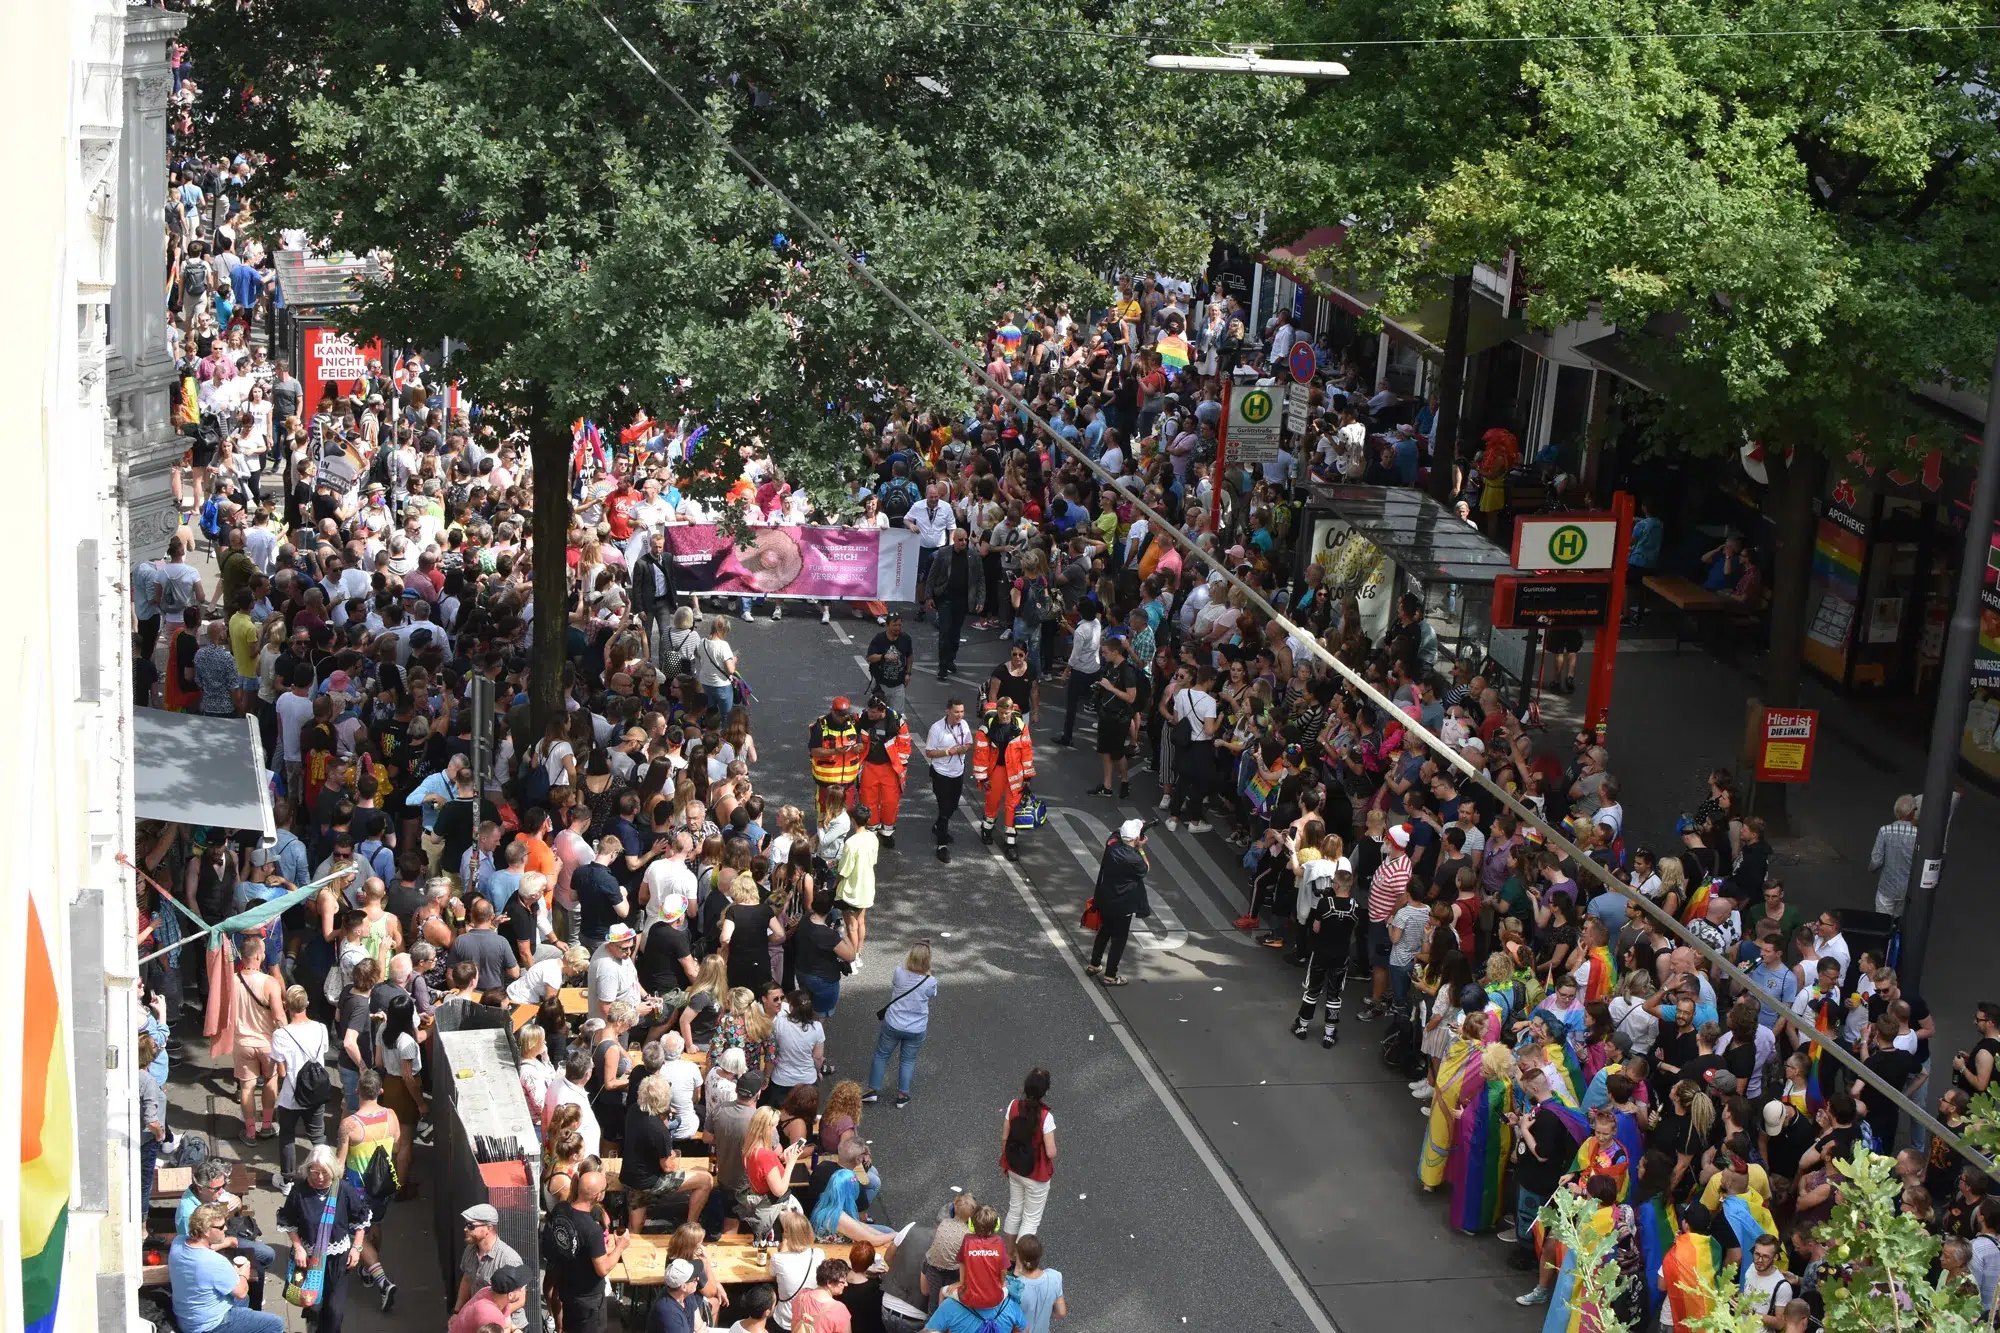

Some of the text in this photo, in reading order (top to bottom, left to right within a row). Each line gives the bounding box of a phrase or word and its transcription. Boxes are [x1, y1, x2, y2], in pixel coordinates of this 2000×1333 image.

[317, 346, 353, 355] KANN
[325, 357, 363, 366] NICHT
[321, 368, 365, 378] FEIERN
[1828, 507, 1865, 535] APOTHEKE
[1767, 713, 1812, 727] Hier ist
[1771, 728, 1784, 736] DIE
